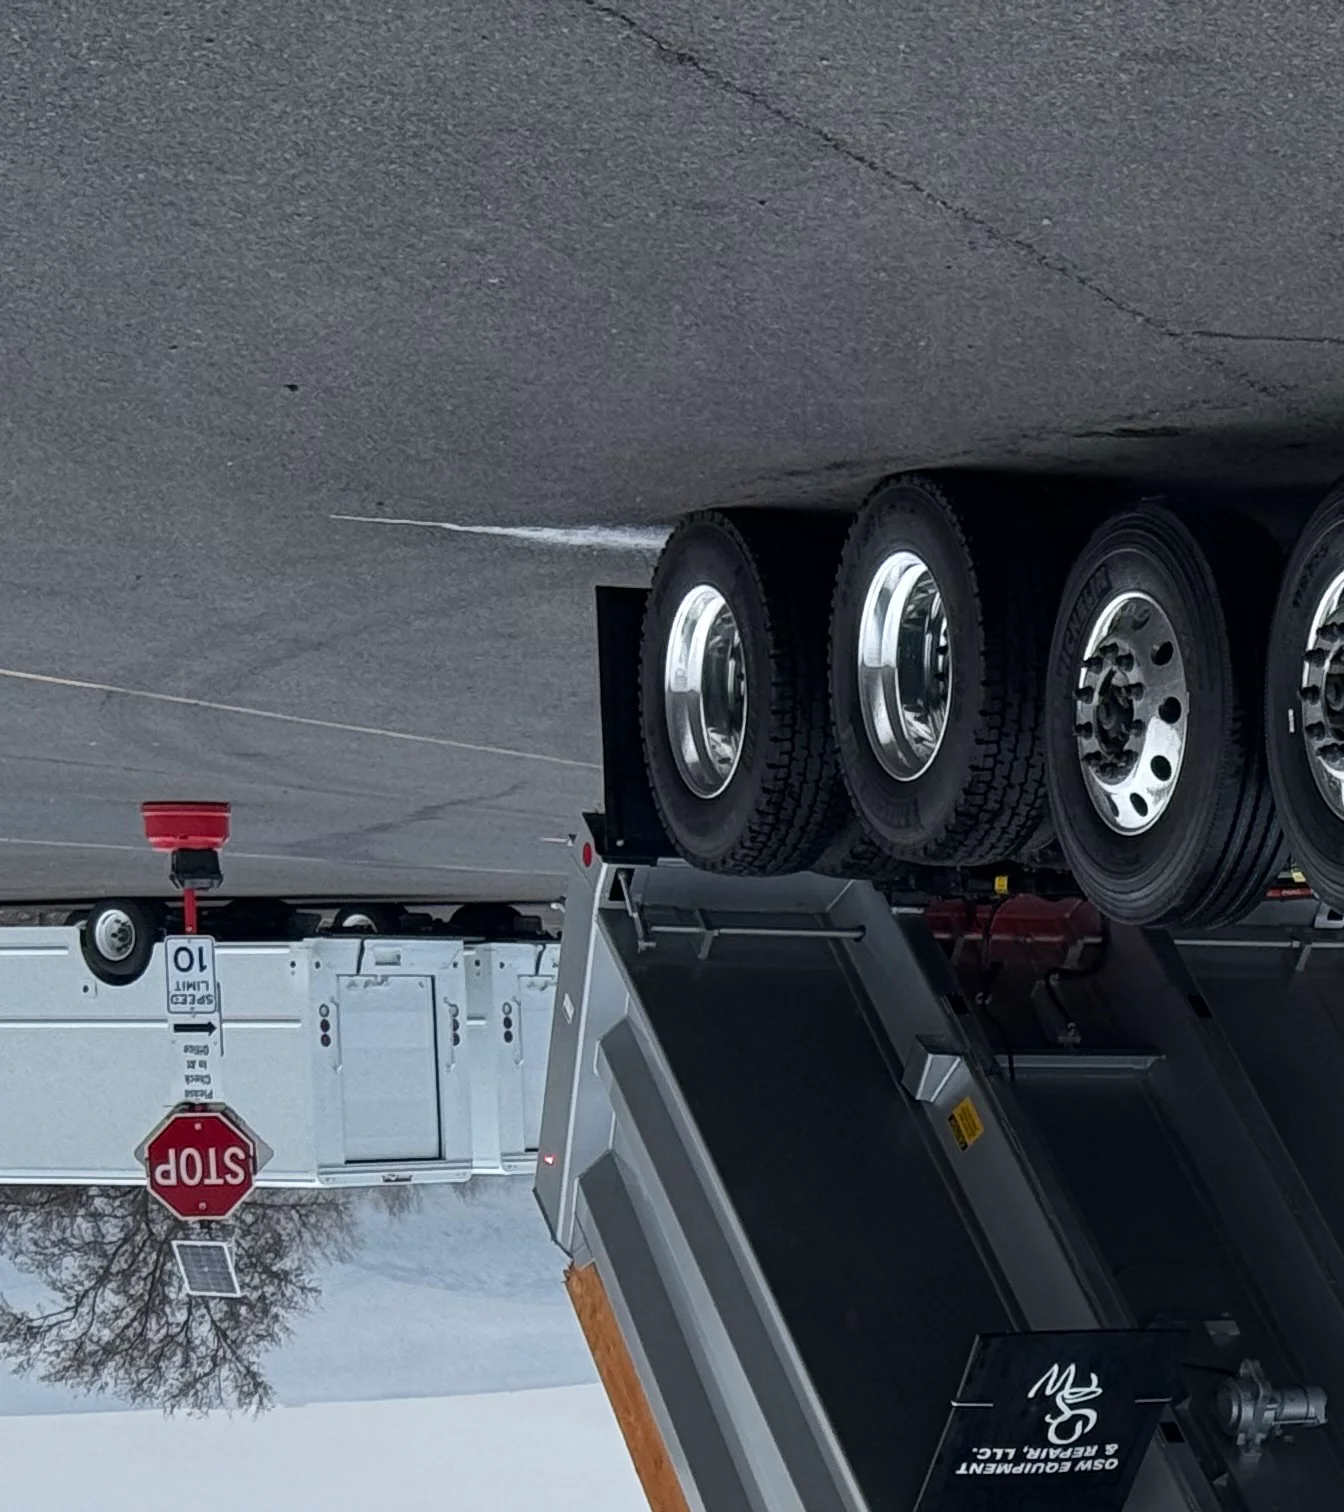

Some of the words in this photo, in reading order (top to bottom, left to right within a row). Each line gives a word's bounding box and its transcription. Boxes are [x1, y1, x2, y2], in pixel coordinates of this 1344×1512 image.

[174, 946, 207, 973] 10
[174, 981, 209, 991] LIMIT
[171, 994, 213, 1005] SPEED
[184, 1074, 212, 1086] Check
[184, 1089, 213, 1100] Please
[154, 1145, 246, 1186] STOP
[972, 1447, 1016, 1460] LLC.
[1022, 1445, 1098, 1459] REPAIR,
[1105, 1443, 1119, 1455] &
[956, 1461, 1072, 1475] EQUIPMENT
[1075, 1458, 1119, 1472] OSW
